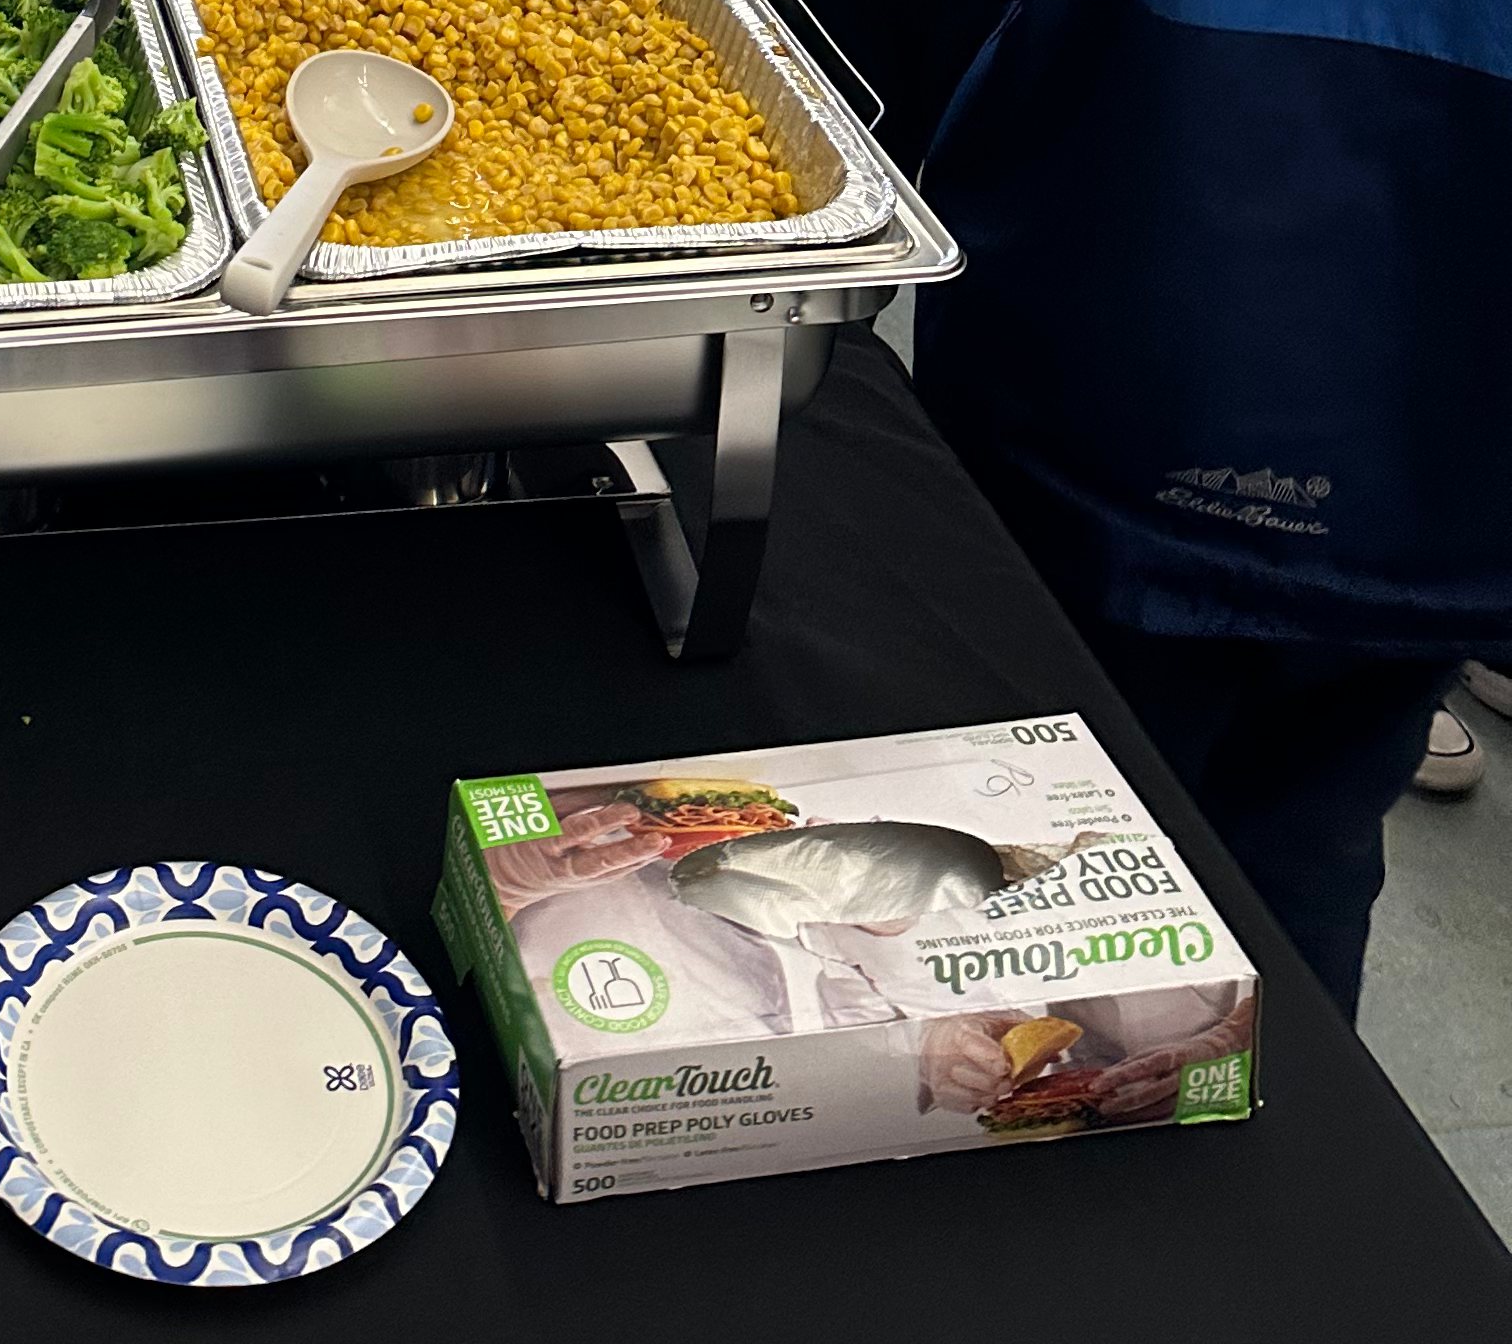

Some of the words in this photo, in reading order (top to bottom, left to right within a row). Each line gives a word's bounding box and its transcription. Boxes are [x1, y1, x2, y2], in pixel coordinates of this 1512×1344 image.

[1011, 721, 1078, 746] 500
[469, 786, 506, 801] MOST
[507, 783, 536, 794] FITS
[472, 792, 543, 821] SIZE
[481, 812, 550, 842] ONE
[1076, 846, 1166, 877] POLY
[1079, 870, 1182, 902] FOOD
[984, 882, 1076, 920] PREP
[1166, 905, 1197, 918] THE
[1064, 914, 1118, 932] CHOICE
[1117, 909, 1166, 923] CLEAR
[915, 932, 993, 950] HANDLING
[994, 928, 1033, 941] FOOD
[1033, 923, 1064, 936] FOR
[652, 975, 667, 1001] SAFE
[556, 989, 606, 1028] CONTACT
[609, 1017, 648, 1031] FOOD
[20, 1040, 31, 1051] CA
[573, 1055, 775, 1106] ClearTouch
[1188, 1058, 1242, 1088] ONE
[1185, 1078, 1242, 1105] SIZE
[574, 1108, 594, 1117] THE
[595, 1106, 630, 1116] CLEAR
[631, 1103, 668, 1114] CHOICE
[669, 1101, 691, 1111] FOR
[691, 1099, 720, 1108] FOOD
[720, 1093, 774, 1106] HANDLING
[573, 1124, 627, 1142] FOOD
[632, 1119, 683, 1137] PREP
[687, 1113, 737, 1132] POLY
[739, 1106, 815, 1128] GLOVES
[571, 1175, 616, 1195] 500
